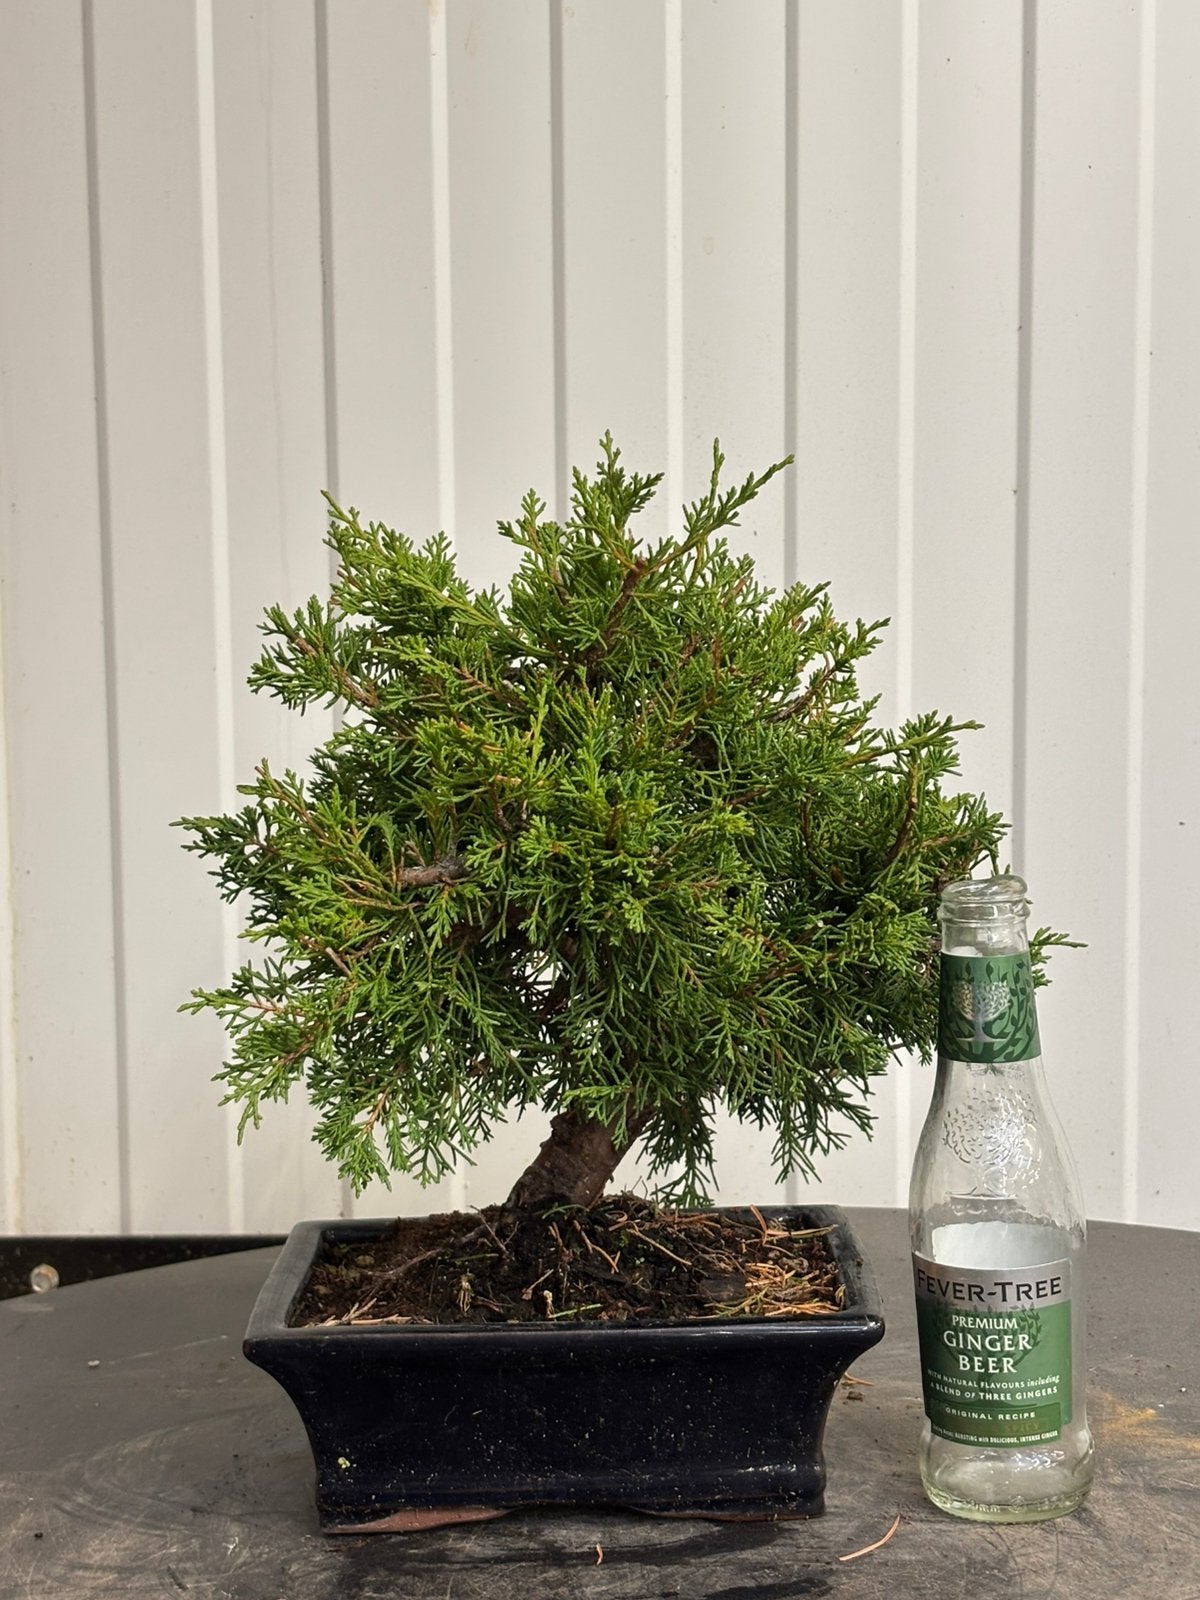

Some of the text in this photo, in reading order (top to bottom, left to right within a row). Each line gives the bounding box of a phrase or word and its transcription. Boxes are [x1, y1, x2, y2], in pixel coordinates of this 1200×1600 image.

[917, 1268, 1062, 1303] FEVER-TREE
[952, 1314, 1019, 1330] PREMIUM
[943, 1330, 1033, 1352] GINGER
[958, 1355, 1018, 1374] BEER
[943, 1375, 979, 1388] NATURAL
[980, 1380, 1025, 1389] FLAVOURS
[1027, 1374, 1060, 1387] including
[935, 1382, 962, 1397] BLEND
[964, 1391, 976, 1399] OF
[979, 1392, 1012, 1401] THREE
[1015, 1385, 1058, 1400] GINGERS
[945, 1407, 1036, 1421] ORIGINAL RECIPE
